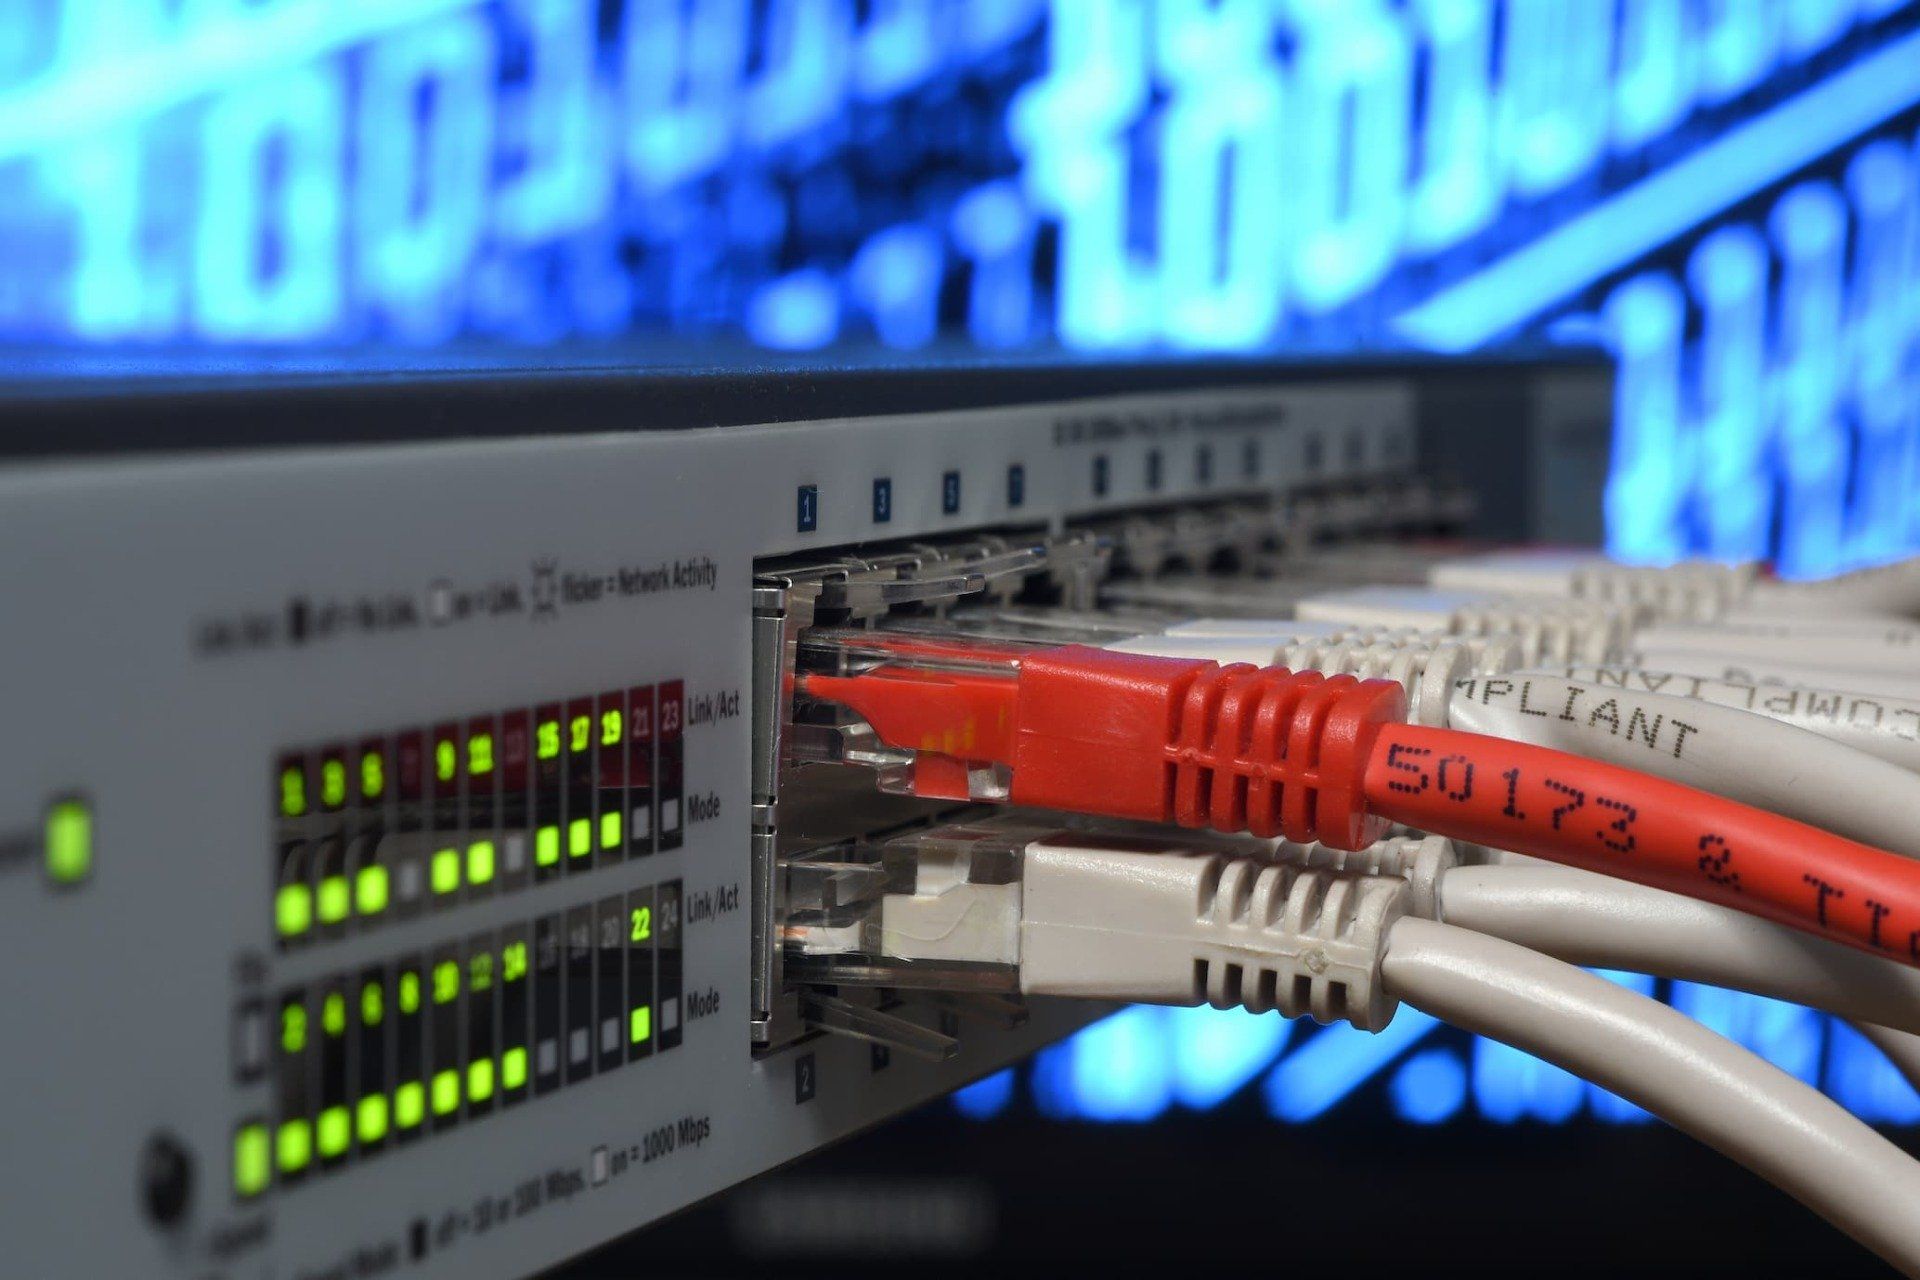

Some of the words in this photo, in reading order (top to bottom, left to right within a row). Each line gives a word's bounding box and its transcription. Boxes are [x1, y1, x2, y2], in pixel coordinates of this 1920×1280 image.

[619, 566, 669, 597] Network
[674, 556, 717, 591] Activity
[633, 706, 650, 738] 21
[662, 700, 679, 732] 23
[687, 690, 740, 726] Link/Act
[687, 791, 721, 824] Mode
[1698, 833, 1741, 892] &
[631, 906, 650, 942] 22
[661, 900, 677, 932] 24
[687, 883, 740, 924] Link/Act
[687, 986, 720, 1022] Mode
[643, 1123, 675, 1163] 1000
[678, 1115, 710, 1149] Mbps
